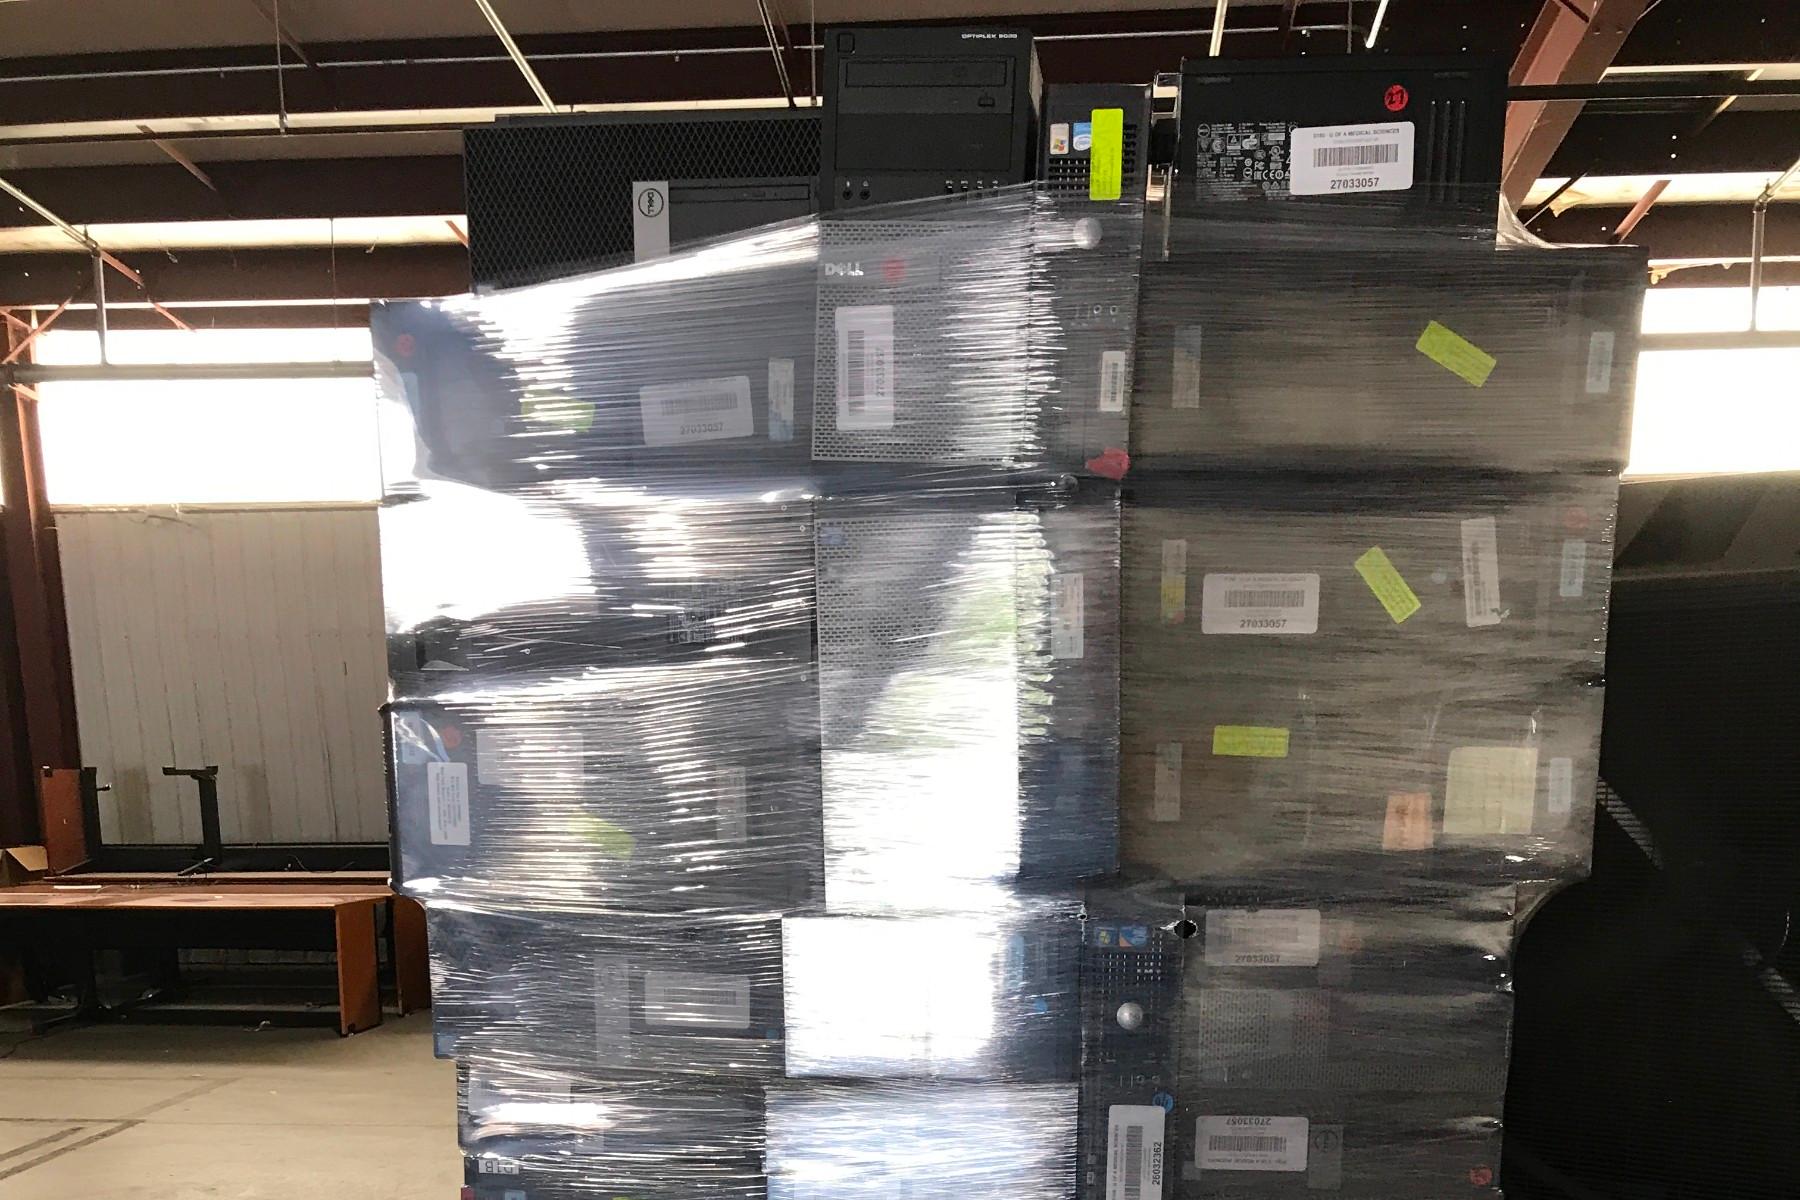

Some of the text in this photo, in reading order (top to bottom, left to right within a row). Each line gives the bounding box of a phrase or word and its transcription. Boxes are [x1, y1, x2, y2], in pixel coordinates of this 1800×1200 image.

[1330, 177, 1380, 189] 27033057
[824, 262, 864, 277] DELL
[1240, 619, 1287, 629] 27033057
[1152, 1142, 1162, 1186] 26032362
